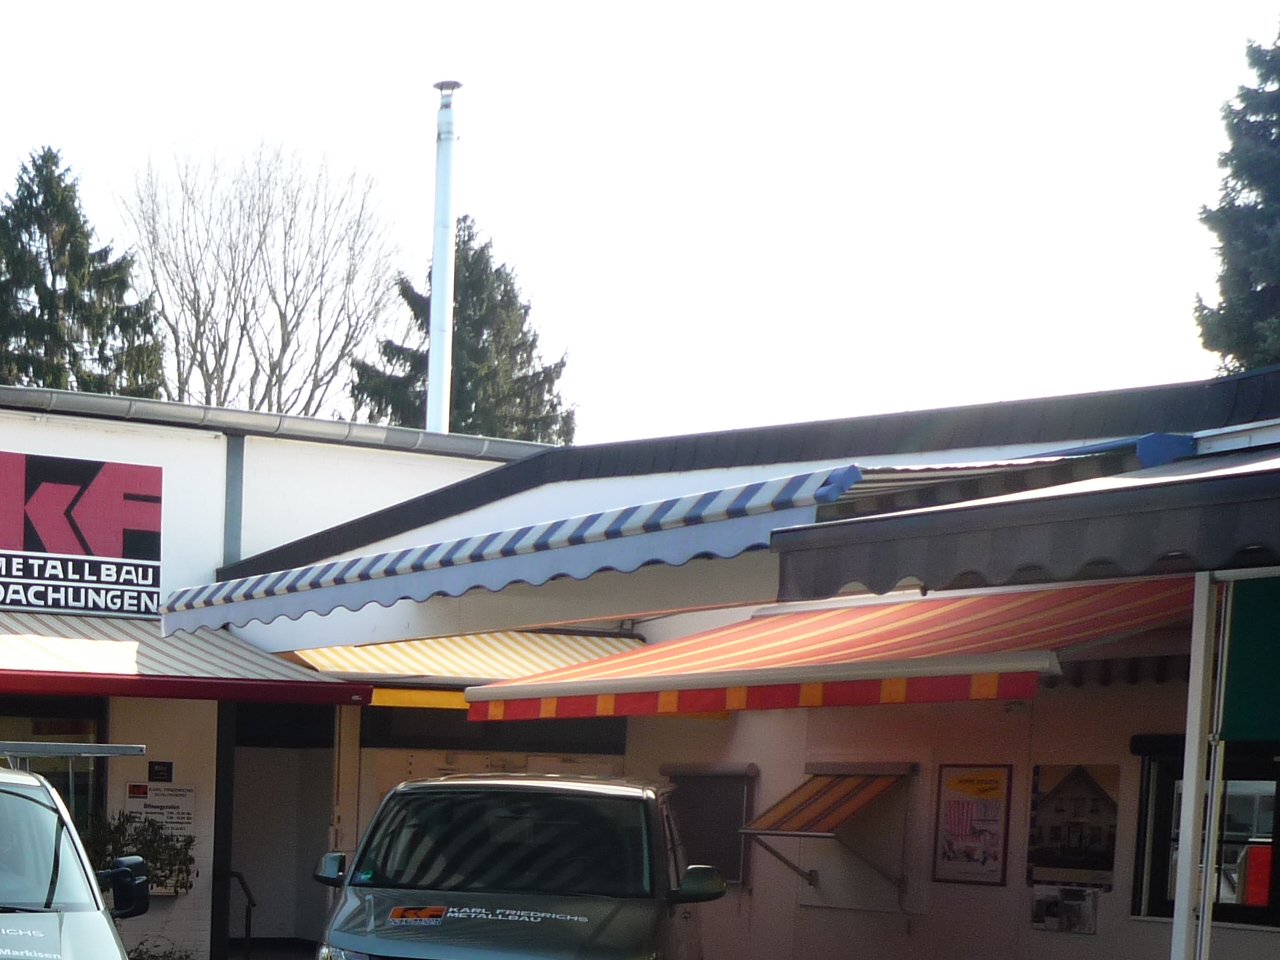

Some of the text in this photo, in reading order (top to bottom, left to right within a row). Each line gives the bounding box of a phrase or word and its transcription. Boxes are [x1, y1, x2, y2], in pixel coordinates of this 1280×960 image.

[446, 912, 542, 923] METALLBAU
[447, 906, 589, 923] KARL FRIEDRICHS
